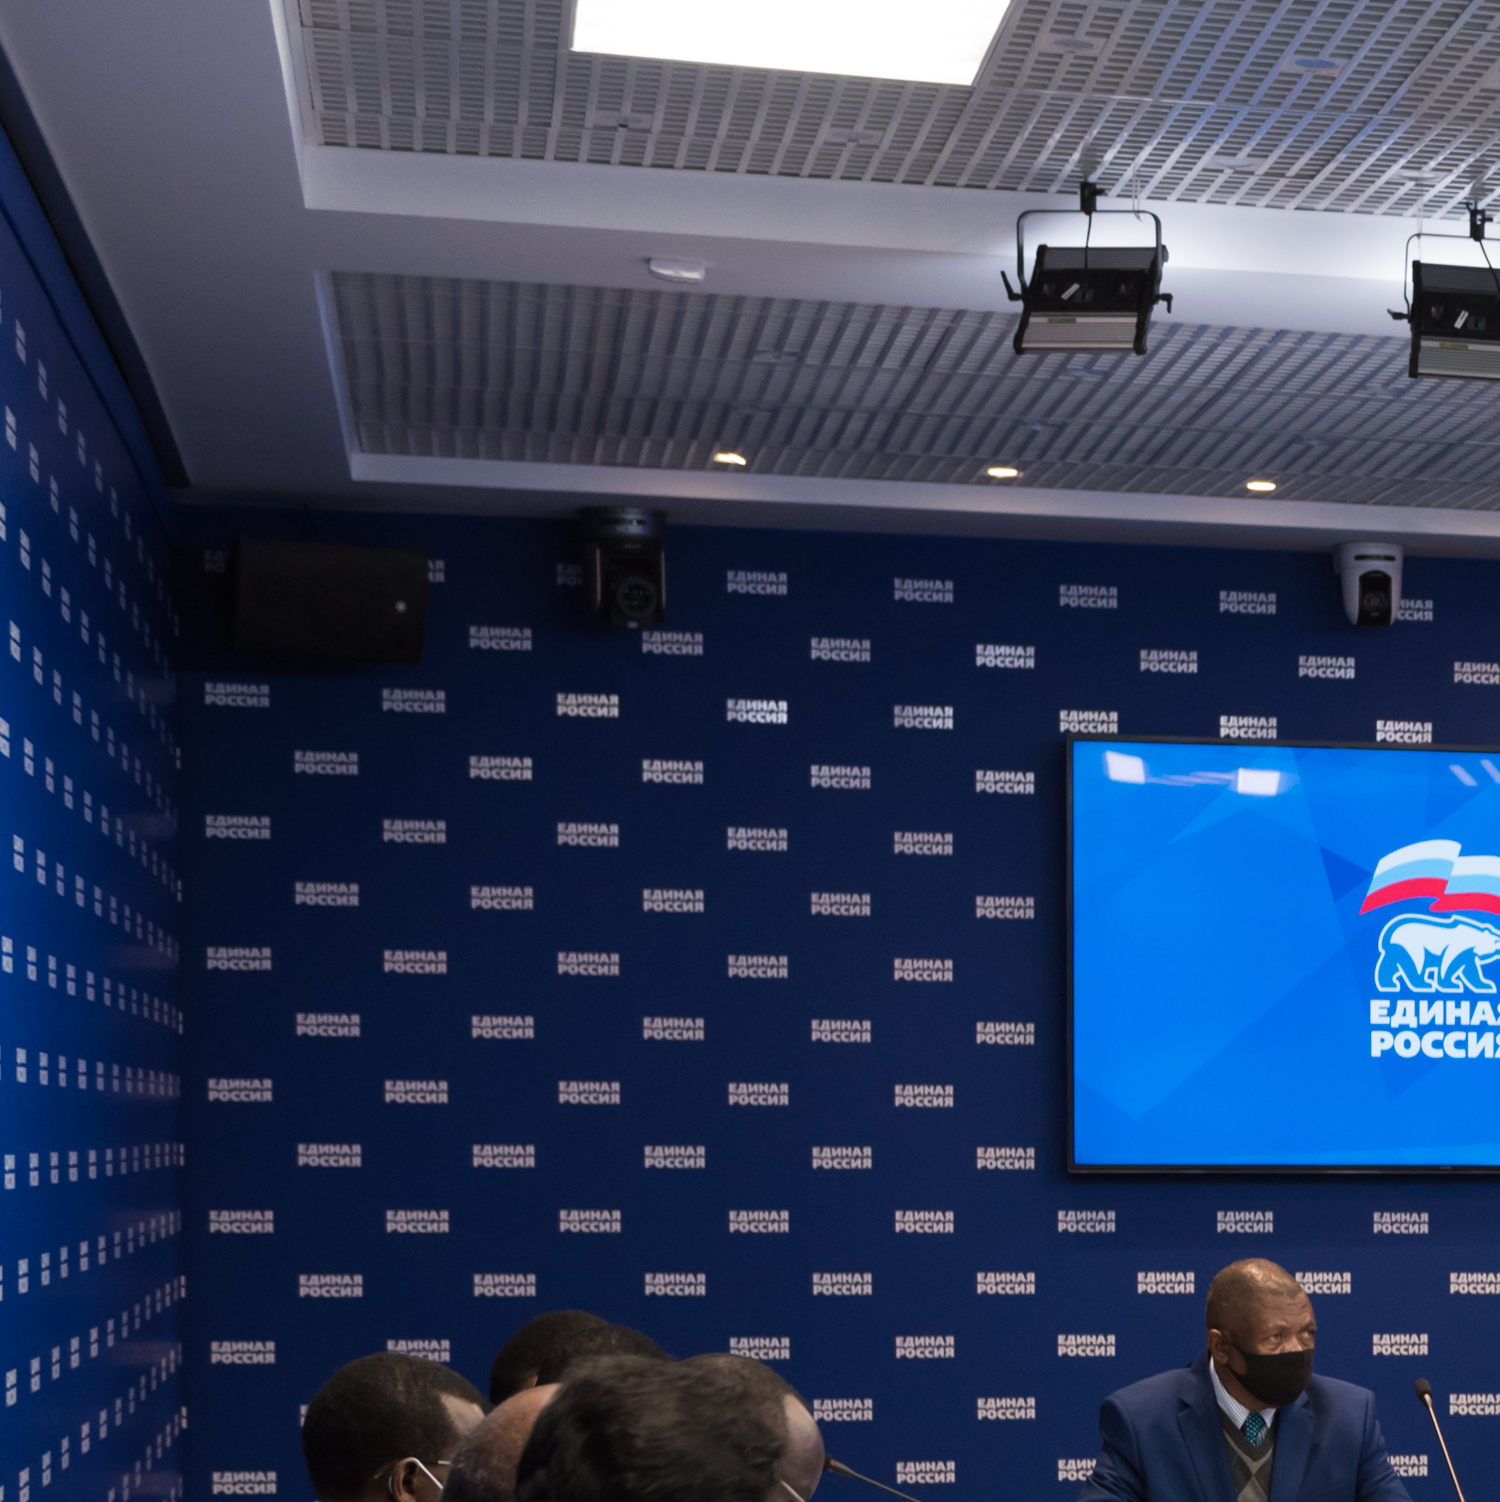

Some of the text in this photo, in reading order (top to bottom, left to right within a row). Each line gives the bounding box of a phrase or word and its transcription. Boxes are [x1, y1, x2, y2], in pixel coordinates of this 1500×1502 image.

[204, 682, 270, 695] ЕДИНАЯ
[204, 694, 270, 707] РОССИЯ
[726, 700, 788, 712] ЕДИНАЯ
[726, 710, 789, 724] РОССИЯ
[1059, 710, 1119, 722] ЕДИНАЯ
[1059, 721, 1119, 733] РОССИЯ
[469, 756, 533, 768] ЕДИНАЯ
[469, 768, 533, 780] РОССИЯ
[810, 765, 871, 778] ЕДИНАЯ
[810, 776, 871, 789] РОССИЯ
[557, 823, 619, 835] ЕДИНАЯ
[557, 834, 620, 846] РОССИЯ
[893, 832, 954, 844] ЕДИНАЯ
[893, 843, 953, 855] РОССИЯ
[642, 889, 705, 901] ЕДИНАЯ
[642, 900, 705, 912] РОССИЯ
[206, 947, 272, 958] ЕДИНАЯ
[206, 958, 272, 970] РОССИЯ
[727, 955, 789, 966] ЕДИНАЯ
[727, 966, 789, 978] РОССИЯ
[975, 1022, 1035, 1033] ЕДИНАЯ
[975, 1033, 1035, 1044] РОССИЯ
[384, 1080, 449, 1092] ЕДИНАЯ
[384, 1092, 449, 1103] РОССИЯ
[811, 1147, 873, 1158] ЕДИНАЯ
[811, 1157, 873, 1169] РОССИЯ
[728, 1210, 790, 1222] ЕДИНАЯ
[1057, 1210, 1116, 1222] ЕДИНАЯ
[1373, 1212, 1429, 1223] ЕДИНАЯ
[729, 1221, 790, 1232] РОССИЯ
[1057, 1221, 1116, 1232] РОССИЯ
[1373, 1223, 1429, 1234] РОССИЯ
[1372, 1334, 1429, 1345] ЕДИНАЯ
[1372, 1344, 1429, 1355] РОССИЯ
[212, 1472, 277, 1483] ЕДИНАЯ
[212, 1482, 277, 1494] РОССИЯ
